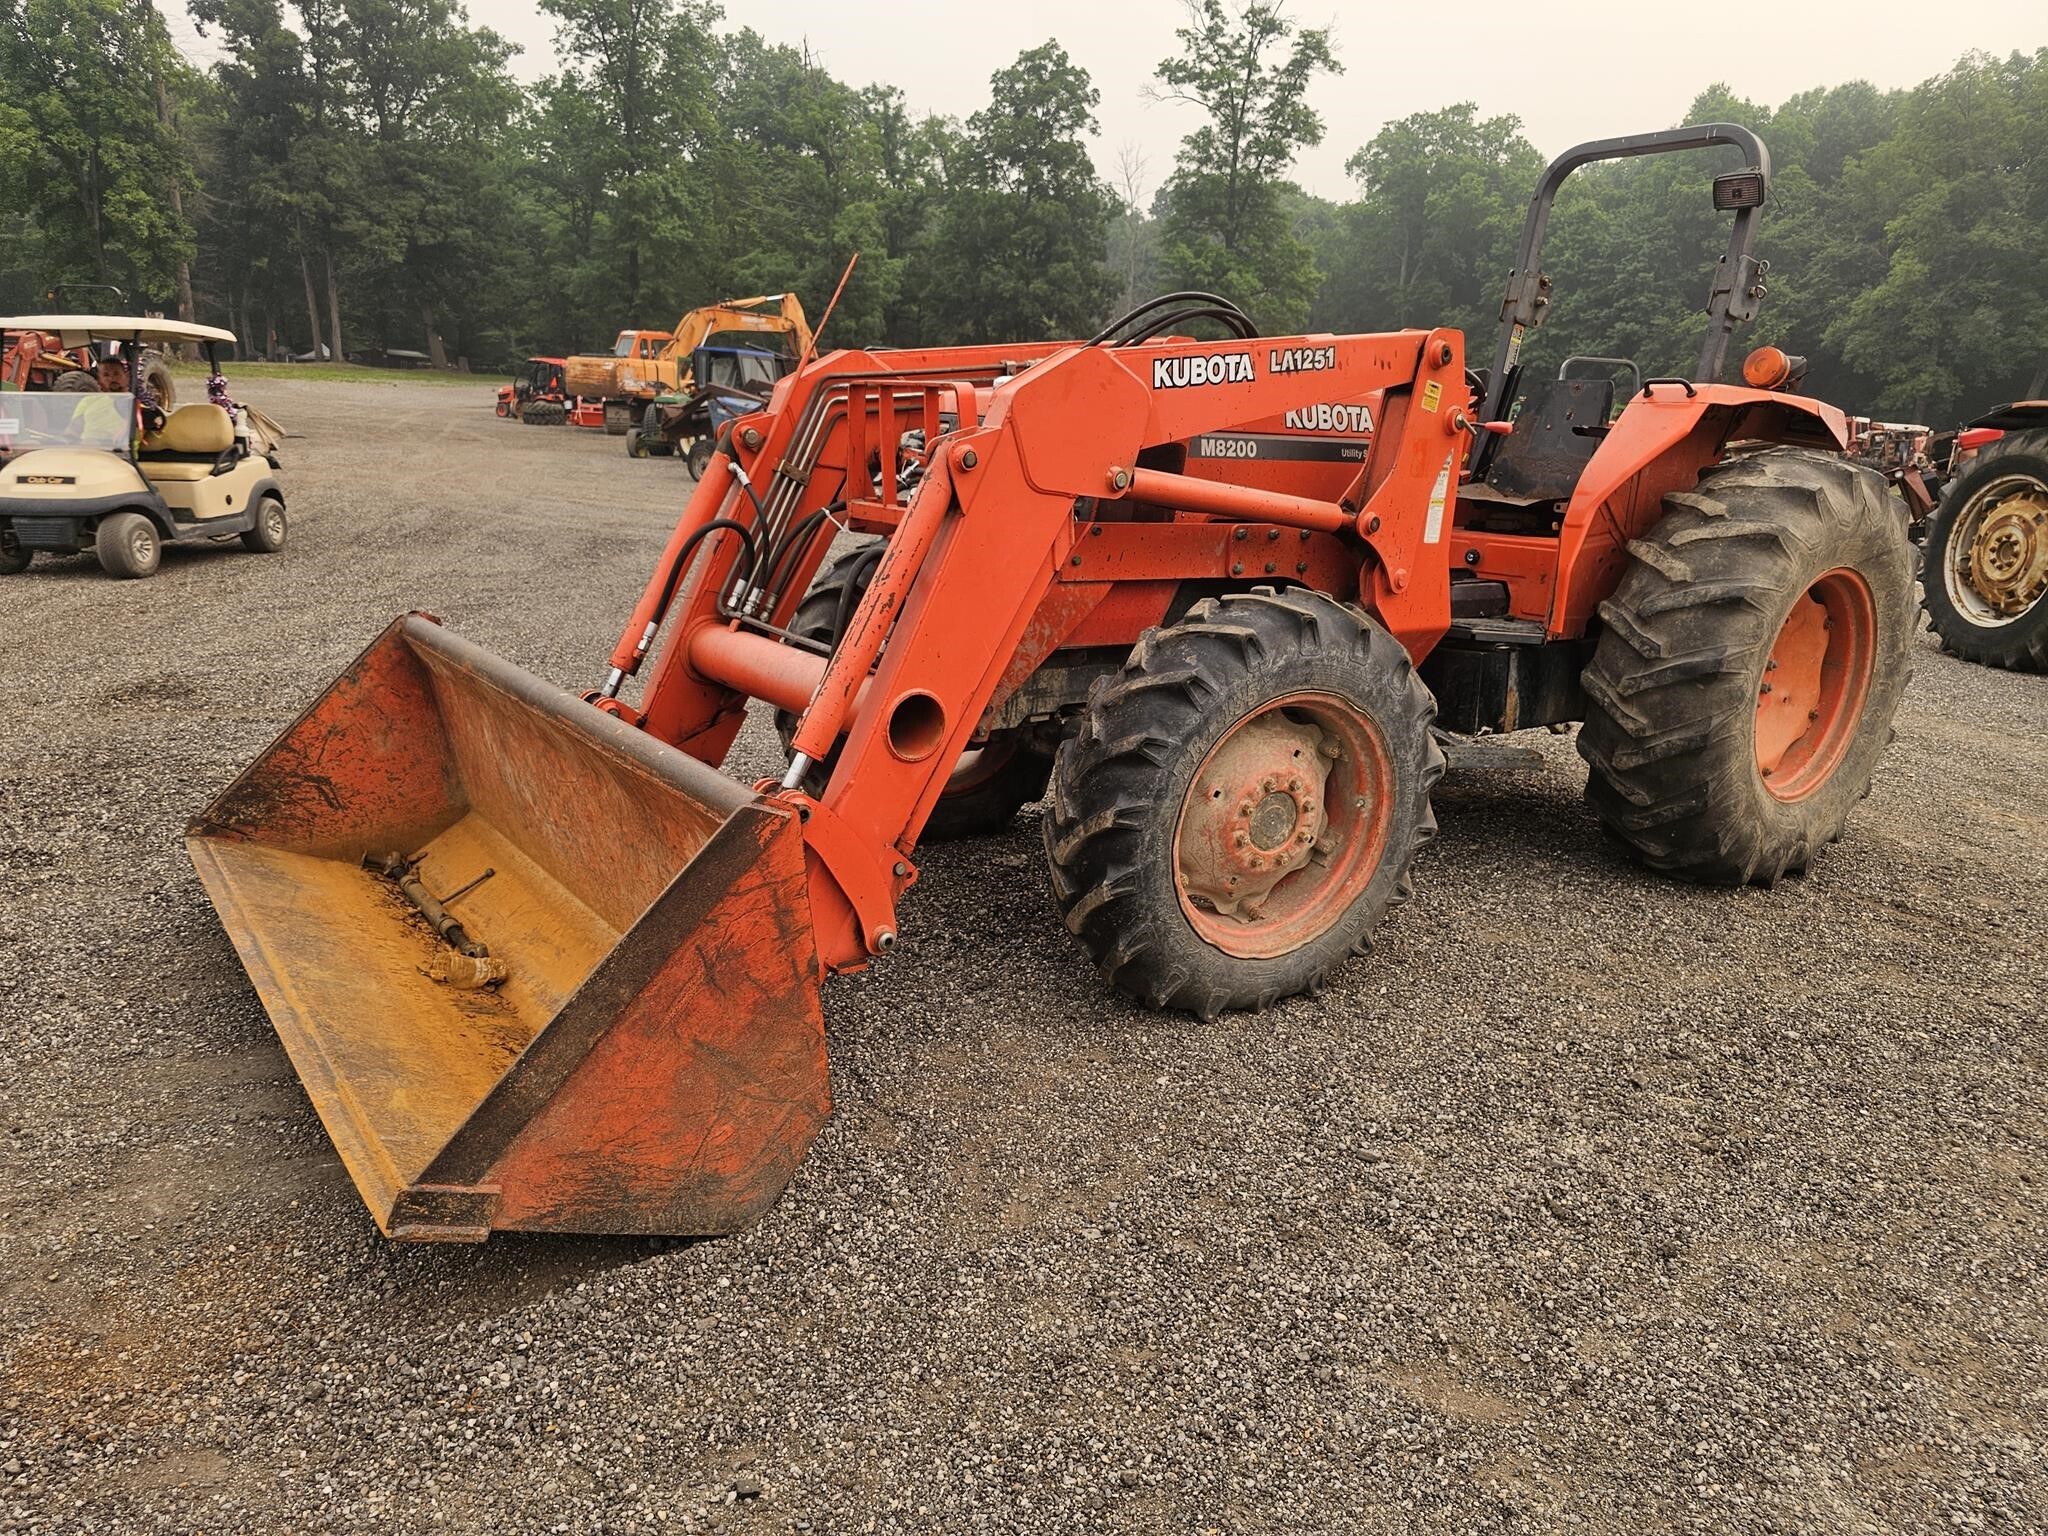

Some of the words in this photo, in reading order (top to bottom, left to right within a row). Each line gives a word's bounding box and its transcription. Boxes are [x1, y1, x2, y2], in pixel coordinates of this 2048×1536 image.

[1153, 353, 1255, 389] KUBOTA
[1270, 346, 1335, 373] LA1251
[1285, 403, 1374, 433] KUBOTA
[1201, 438, 1257, 458] M8200
[1341, 448, 1362, 459] Utility
